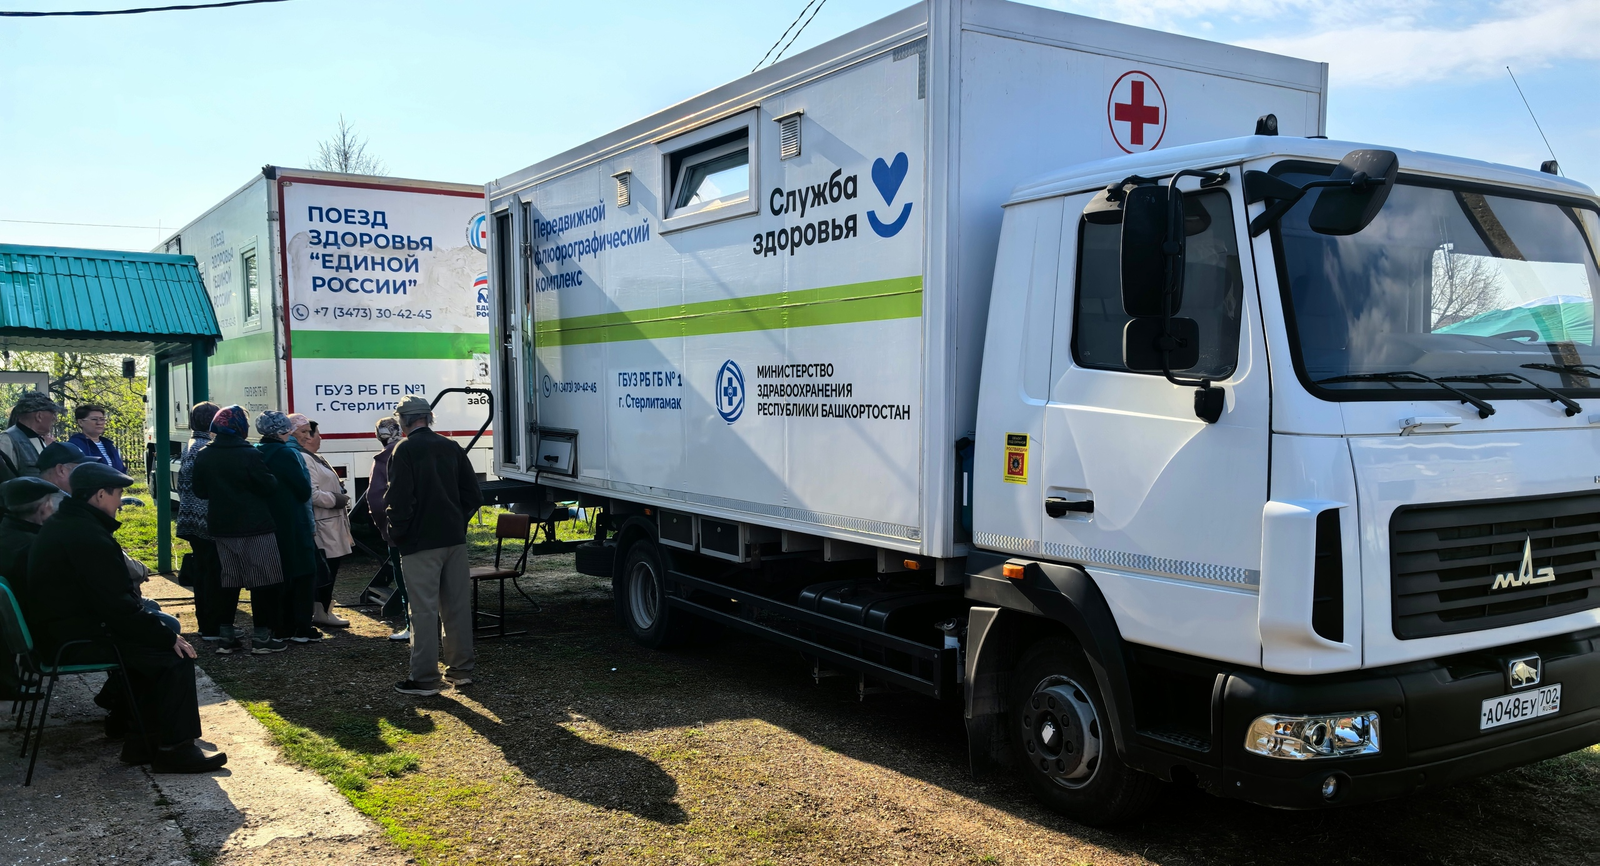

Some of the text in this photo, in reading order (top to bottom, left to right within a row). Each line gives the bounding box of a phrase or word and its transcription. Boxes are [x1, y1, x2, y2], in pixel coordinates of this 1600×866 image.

[770, 168, 857, 218] Служба
[308, 206, 388, 229] ПОЕЗД
[533, 198, 606, 242] Передвижной
[308, 229, 433, 251] ЗДОРОВЬЯ
[534, 217, 650, 270] флюорографический
[753, 214, 857, 257] здоровья
[310, 252, 419, 273] “ЕДИНОЙ
[312, 276, 417, 295] РОССИИ”
[535, 270, 583, 293] комплекс
[314, 307, 432, 320] +7 (3473) 30-42-45
[618, 372, 638, 387] ГБУЗ
[639, 372, 650, 387] РБ
[652, 371, 663, 387] ГБ
[757, 363, 834, 378] МИНИСТЕРСТВО
[315, 384, 426, 396] ГБУЗ РБ ГБ №1
[574, 382, 597, 393] 30-42-45
[757, 383, 853, 399] ЗДРАВООХРАНЕНИЯ
[316, 400, 399, 413] г. Стерлита
[618, 393, 682, 412] г. Стерлитамак
[757, 403, 910, 420] РЕСПУБЛИКИ БАШКОРТОСТАН
[1485, 688, 1558, 725] А048ЕУ 702
